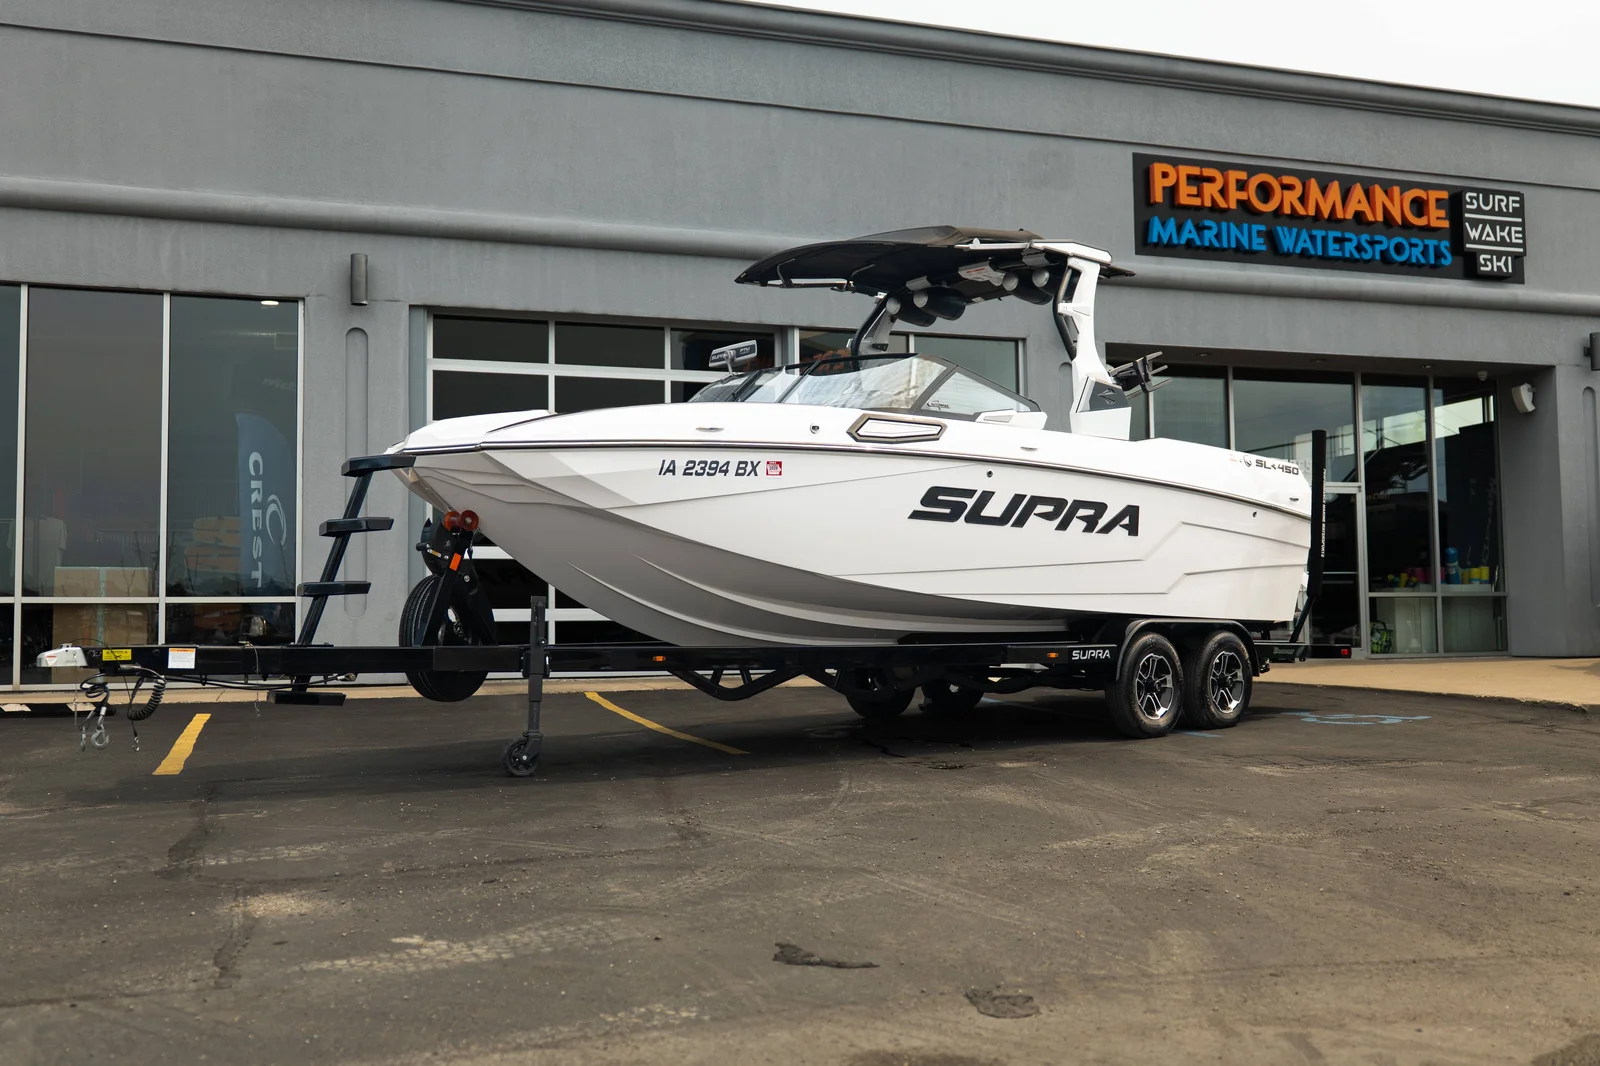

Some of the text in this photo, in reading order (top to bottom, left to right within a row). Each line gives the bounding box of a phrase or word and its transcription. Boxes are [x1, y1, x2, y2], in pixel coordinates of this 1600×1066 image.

[1149, 162, 1450, 229] PERFORMANCE
[1465, 192, 1520, 213] SURF
[1147, 216, 1453, 267] MARINE WATERSPORTS
[1465, 222, 1523, 243] WAKE
[1480, 254, 1512, 273] SKI
[658, 459, 761, 476] IA 2394 BX
[248, 451, 264, 588] CREST
[907, 485, 1140, 537] SUPRA
[1072, 649, 1111, 660] SUPRA
